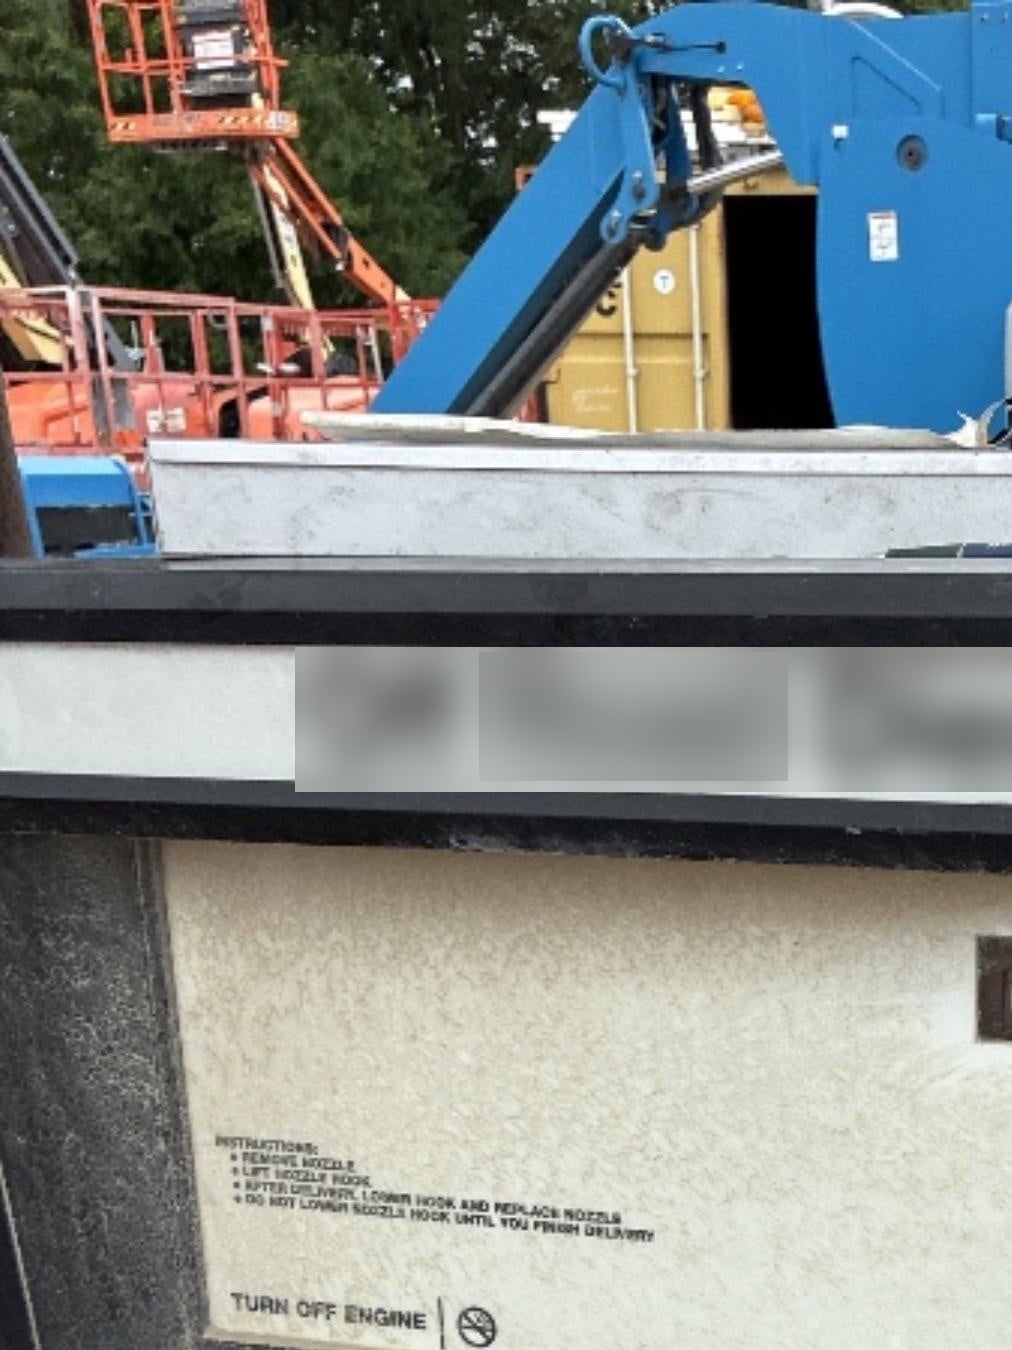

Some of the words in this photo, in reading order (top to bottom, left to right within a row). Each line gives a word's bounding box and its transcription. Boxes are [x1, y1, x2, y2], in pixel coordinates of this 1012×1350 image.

[461, 1199, 489, 1212] AND
[455, 1214, 495, 1227] UNTIL
[501, 1218, 528, 1231] YOU
[231, 1292, 288, 1314] TURN
[297, 1301, 336, 1320] OFF
[345, 1304, 427, 1329] ENGINE
